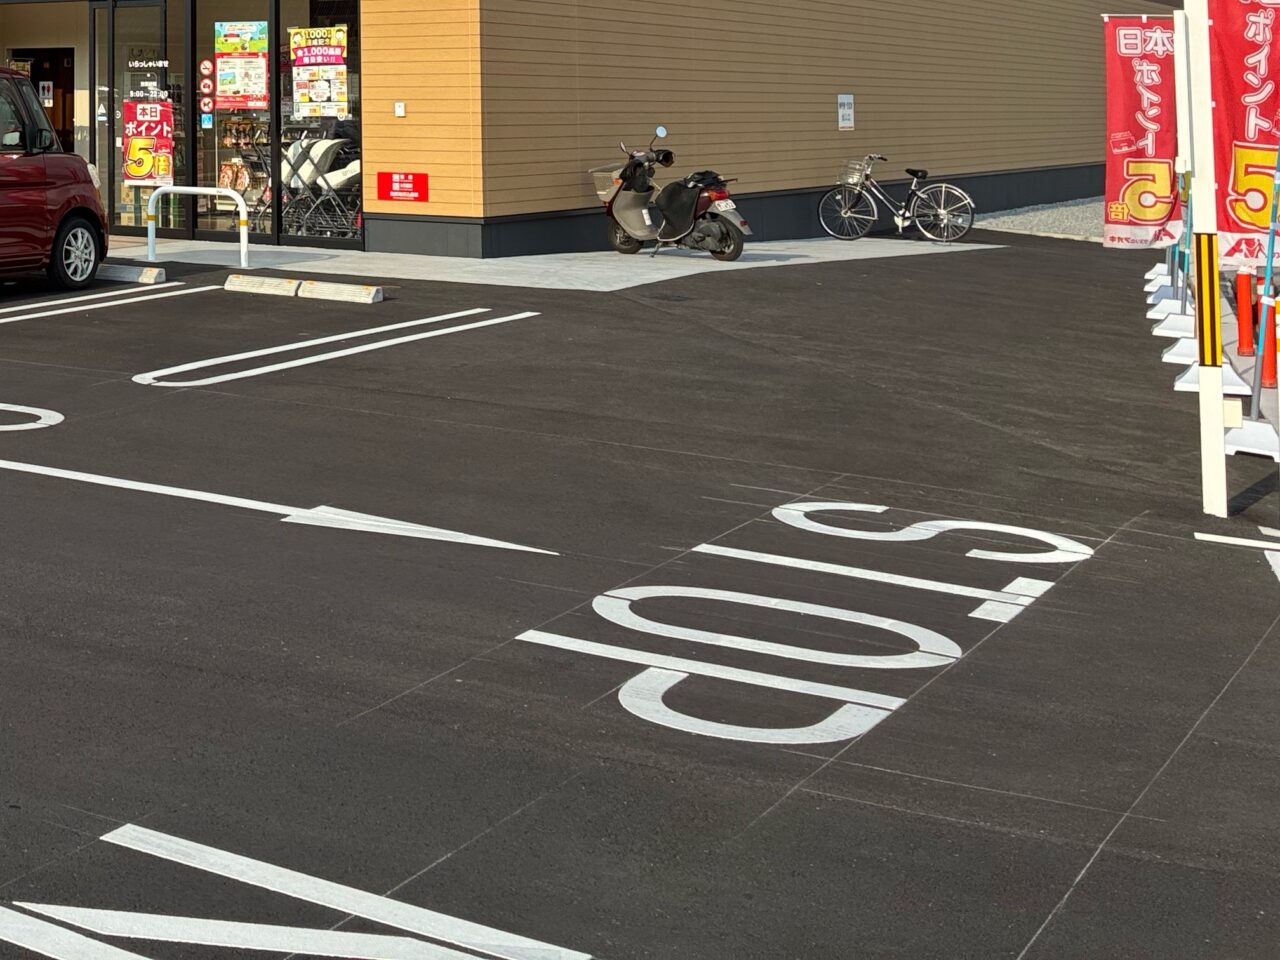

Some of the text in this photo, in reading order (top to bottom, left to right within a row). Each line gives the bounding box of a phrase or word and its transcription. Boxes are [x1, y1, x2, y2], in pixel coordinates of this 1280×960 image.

[1242, 8, 1276, 141] ポイント
[125, 120, 172, 138] ポイント
[138, 106, 158, 119] 本日
[515, 501, 1094, 744] STOP
